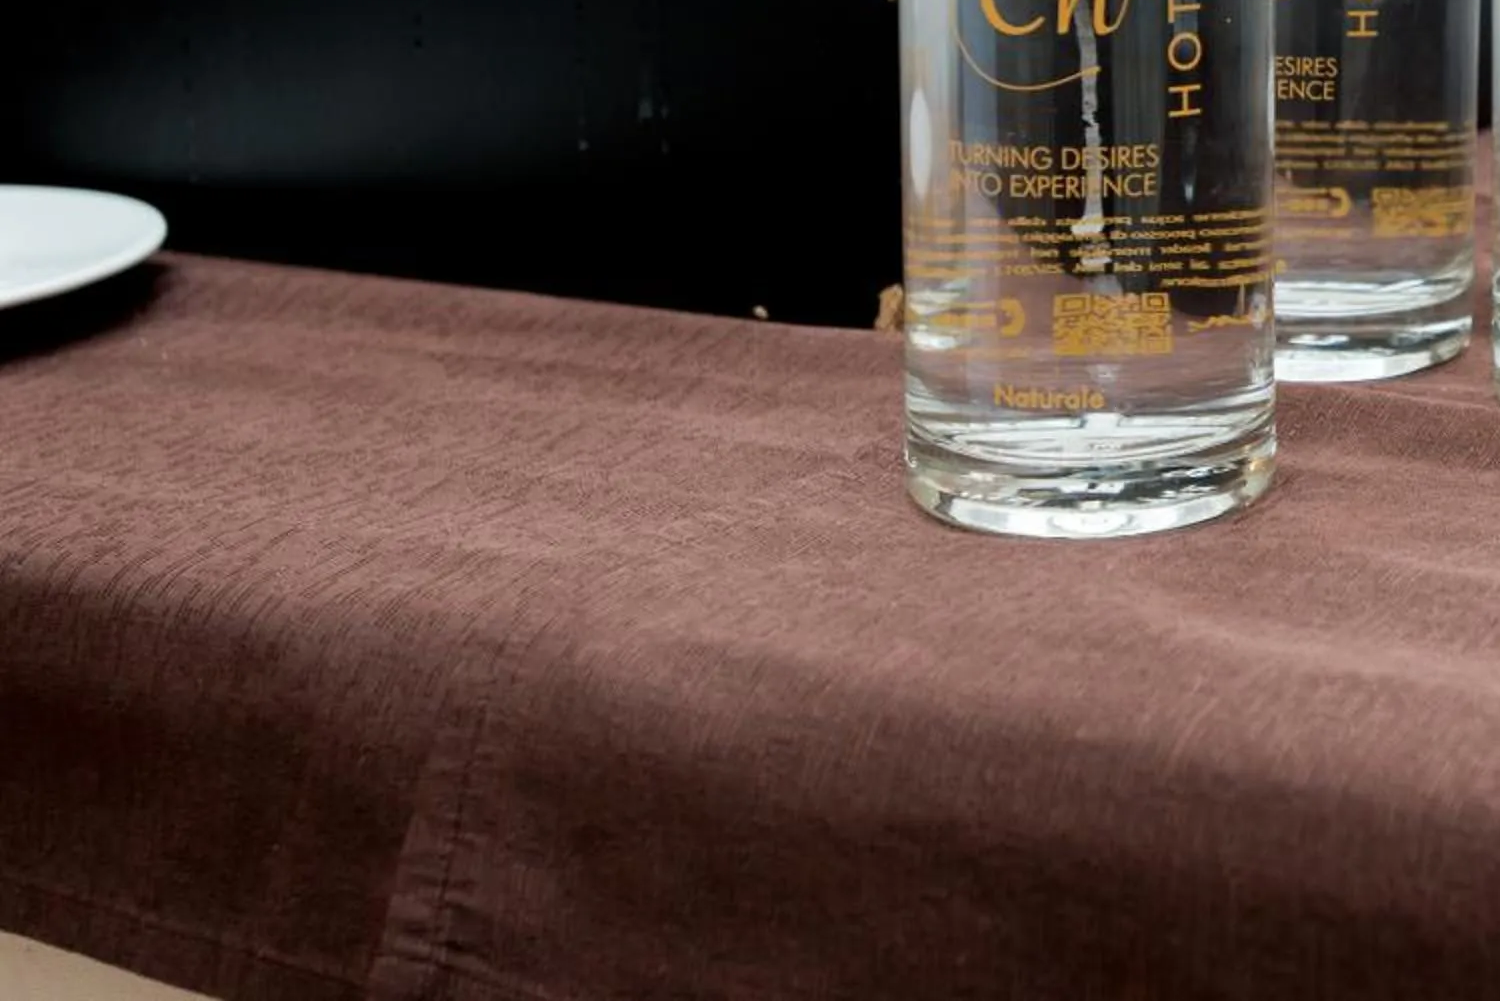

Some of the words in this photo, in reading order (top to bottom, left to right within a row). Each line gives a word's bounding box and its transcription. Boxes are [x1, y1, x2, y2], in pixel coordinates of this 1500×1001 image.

[1274, 55, 1338, 78] ESIRES
[948, 140, 1054, 171] TURNING
[1061, 144, 1160, 171] DESIRES
[1009, 173, 1158, 199] EXPERINCE
[993, 382, 1106, 410] Naturale
